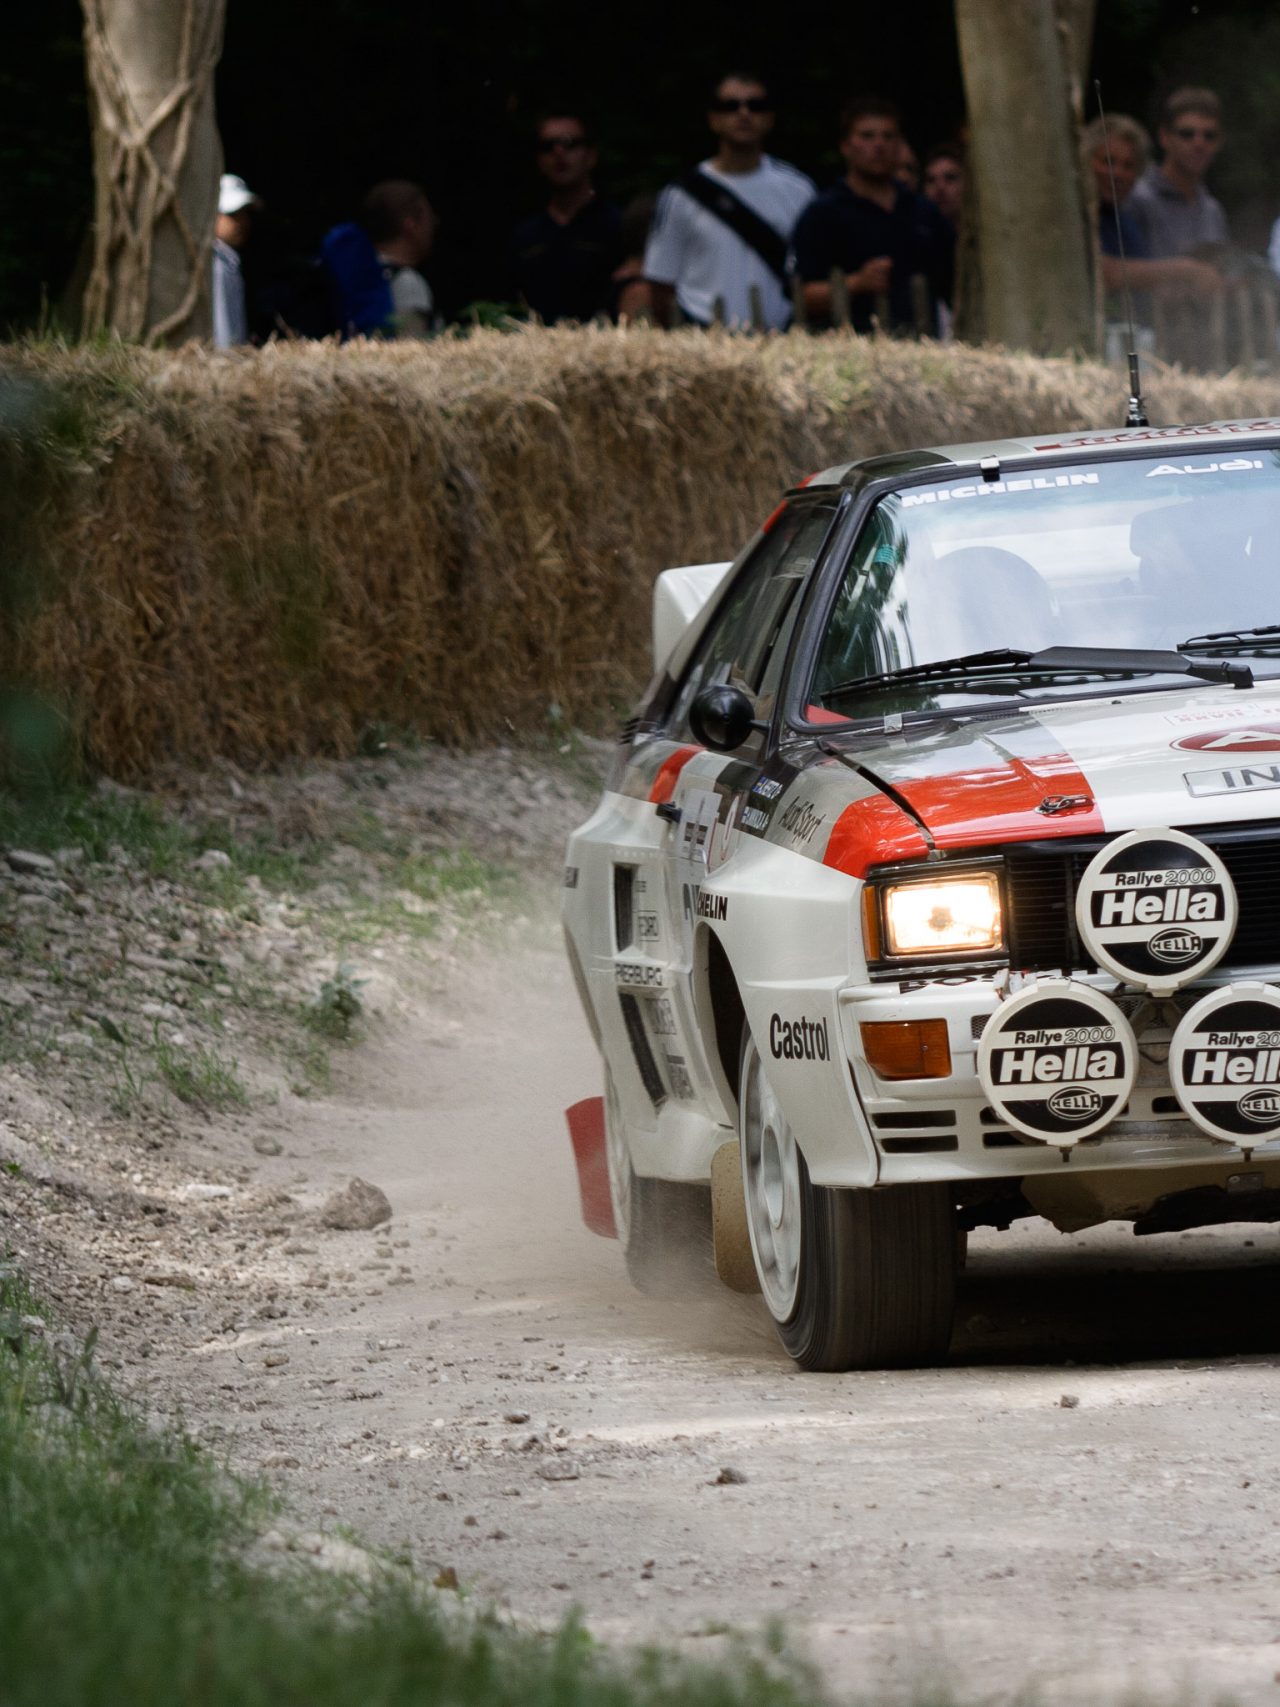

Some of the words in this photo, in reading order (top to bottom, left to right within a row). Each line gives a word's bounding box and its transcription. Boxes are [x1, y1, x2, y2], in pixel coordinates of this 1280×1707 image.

[1146, 459, 1263, 477] Audi
[902, 473, 1099, 507] MICHELIN
[1115, 872, 1163, 887] Rallye
[1164, 868, 1216, 886] 2000
[1101, 888, 1217, 925] Hella
[1151, 936, 1203, 953] HELLA
[769, 1013, 830, 1061] Castrol
[1015, 1031, 1062, 1046] Rallye
[1064, 1027, 1116, 1044] 2000
[1208, 1032, 1255, 1048] Rallye
[1000, 1047, 1117, 1083] Hella
[1050, 1095, 1102, 1111] HELLA
